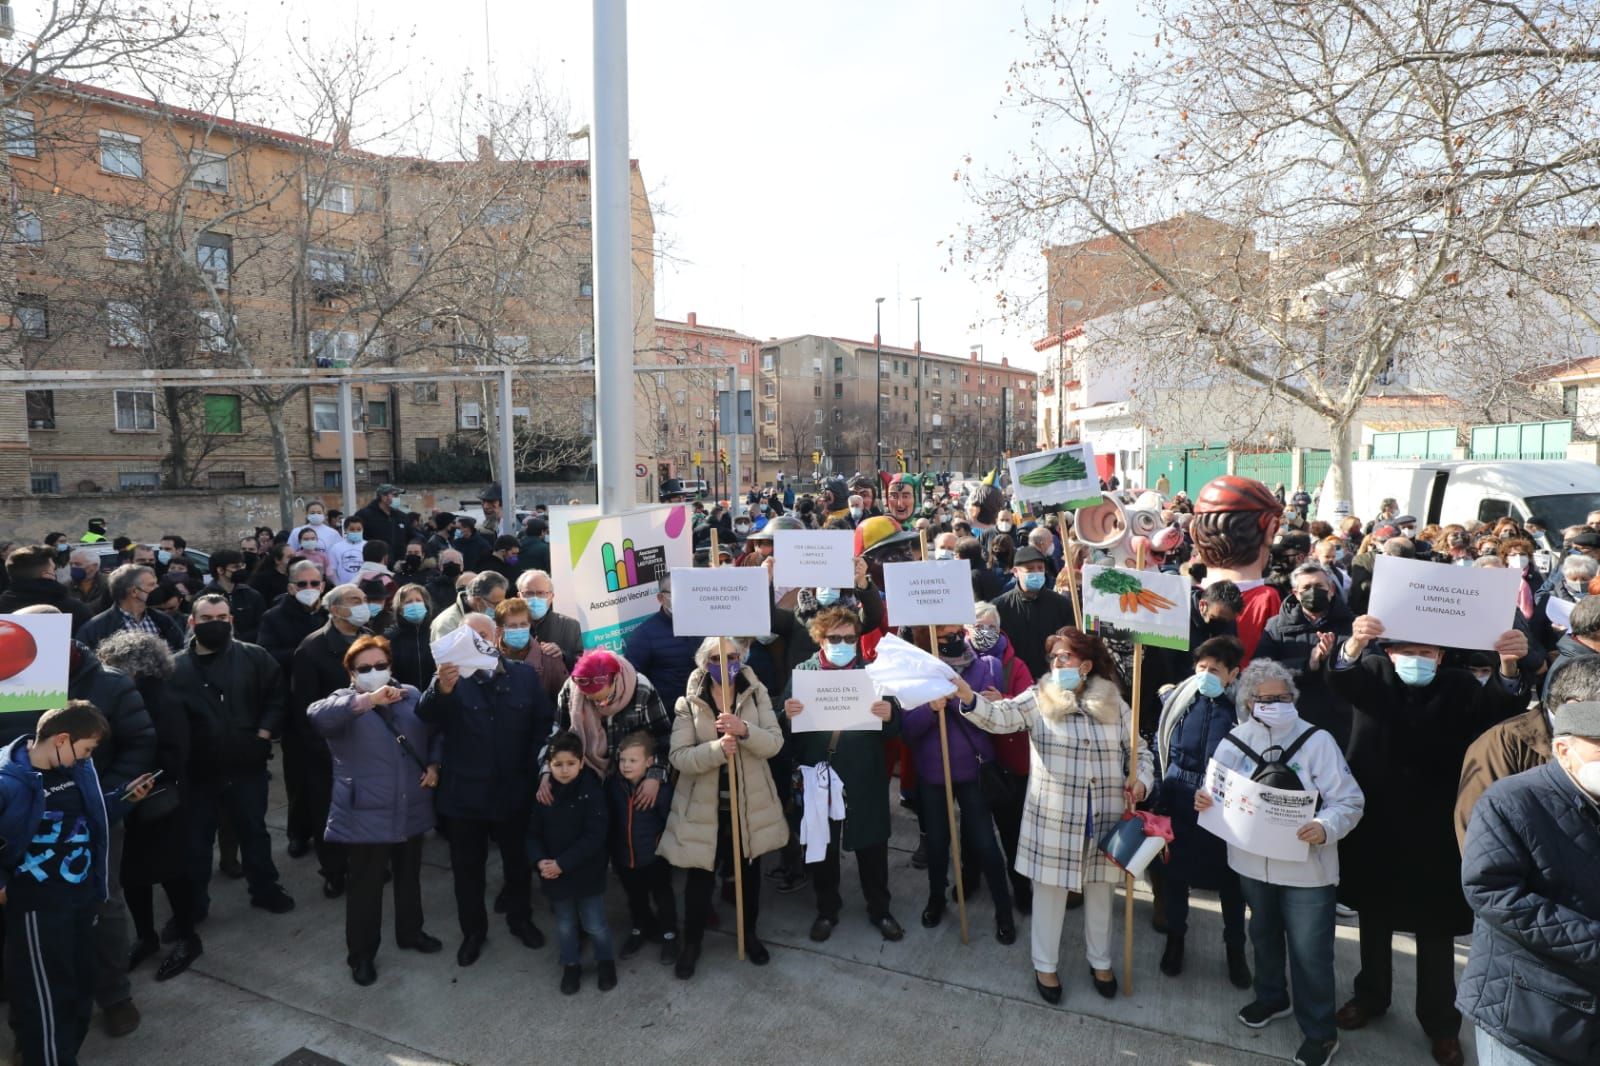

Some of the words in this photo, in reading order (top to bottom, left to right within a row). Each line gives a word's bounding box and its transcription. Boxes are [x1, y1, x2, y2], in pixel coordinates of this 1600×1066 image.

[1451, 588, 1480, 596] CALLES
[590, 594, 628, 610] Asociación
[628, 588, 650, 601] Vecinal
[1424, 595, 1455, 604] LIMPIAS
[1415, 605, 1465, 616] ILUMINADAS
